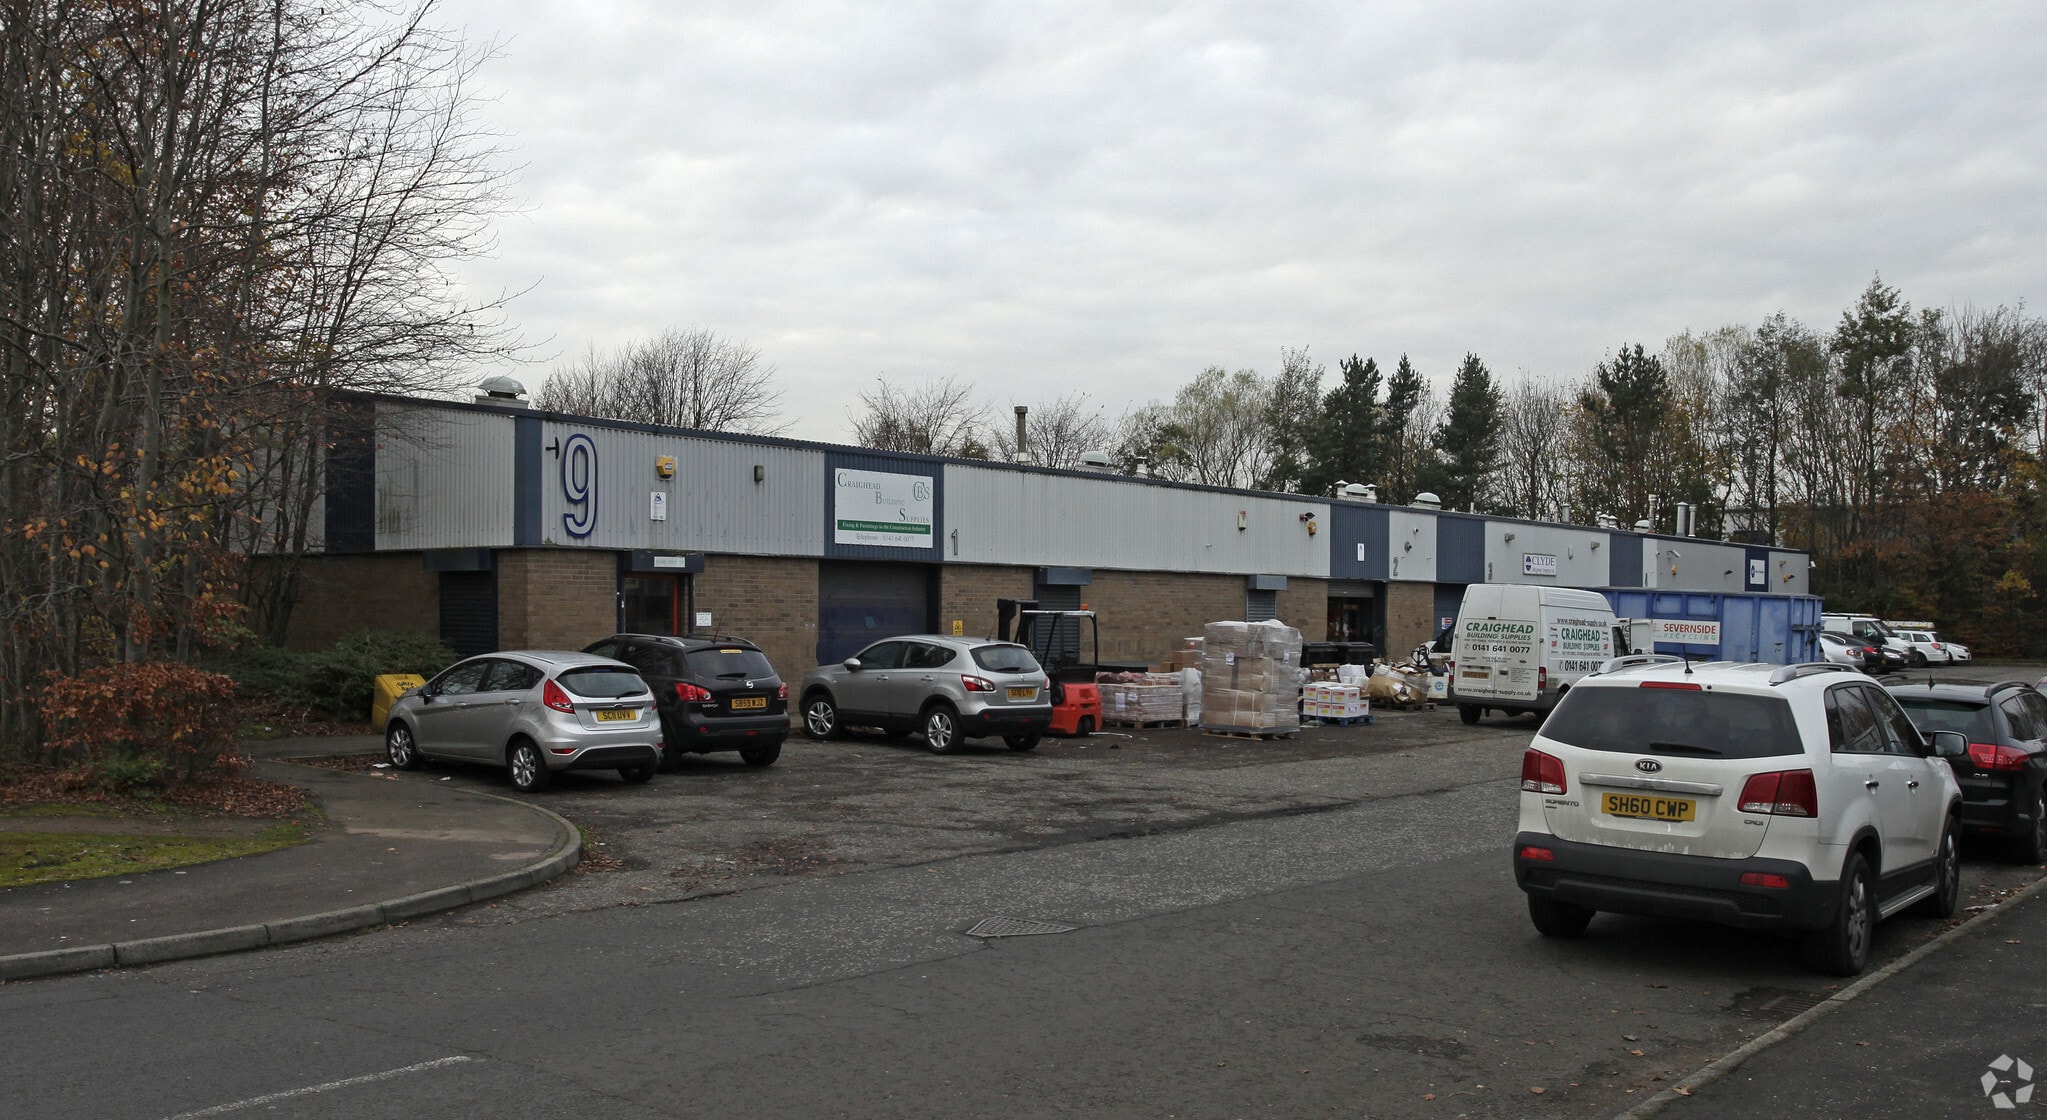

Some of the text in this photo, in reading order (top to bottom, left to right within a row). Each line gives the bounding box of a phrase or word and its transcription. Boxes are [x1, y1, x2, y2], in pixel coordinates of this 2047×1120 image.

[564, 434, 598, 539] 9
[838, 472, 881, 490] CRAIGHEAD
[856, 533, 878, 541] Telephone
[951, 528, 959, 556] 1
[1393, 556, 1399, 577] 2
[1532, 556, 1556, 567] CLYDE
[1466, 622, 1534, 634] CRAIGHEAD
[1664, 623, 1716, 634] SEVERNSIDE
[1561, 628, 1600, 642] CRAIGHEAD
[1664, 633, 1717, 641] RECYCLING
[1472, 644, 1531, 654] 0141 641 0077
[1563, 642, 1600, 651] BUILDING SUPPLIES
[1565, 660, 1578, 671] 0141
[1579, 661, 1589, 672] 641
[1458, 687, 1532, 697] www.craighead-supply.co.uk
[1639, 762, 1658, 771] KIA
[1608, 796, 1689, 818] SH60 CWP
